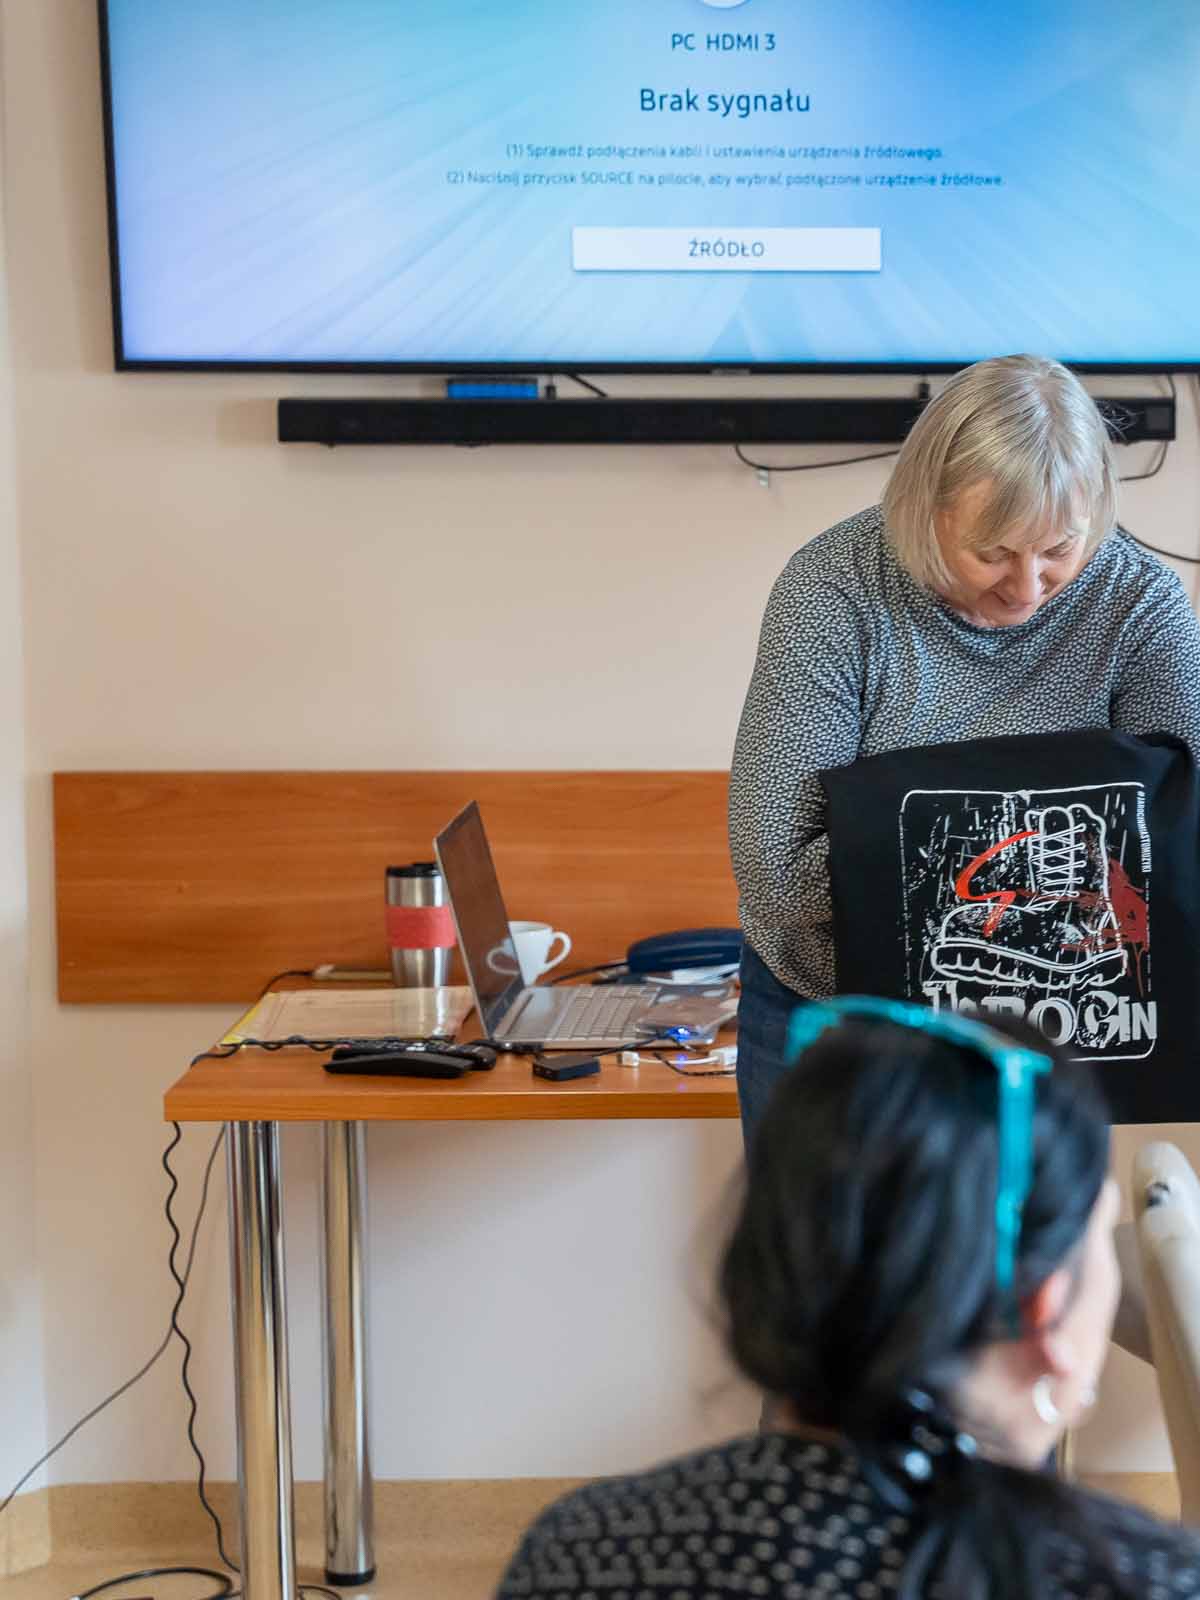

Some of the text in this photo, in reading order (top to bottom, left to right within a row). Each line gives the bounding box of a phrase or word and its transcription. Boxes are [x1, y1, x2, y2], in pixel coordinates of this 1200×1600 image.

[671, 34, 776, 51] PC HDMI 3
[640, 88, 811, 120] Brak sygnału
[527, 144, 584, 160] Sprawdź
[587, 144, 667, 160] podłączenia
[713, 144, 786, 159] ustawienia
[788, 144, 861, 161] urządzenia
[523, 171, 577, 187] przycisk
[581, 172, 634, 186] SOURCE
[638, 174, 654, 186] na
[708, 172, 732, 188] aby
[736, 171, 783, 188] wybrać
[786, 171, 862, 188] podłączone
[865, 172, 937, 188] urządzenie
